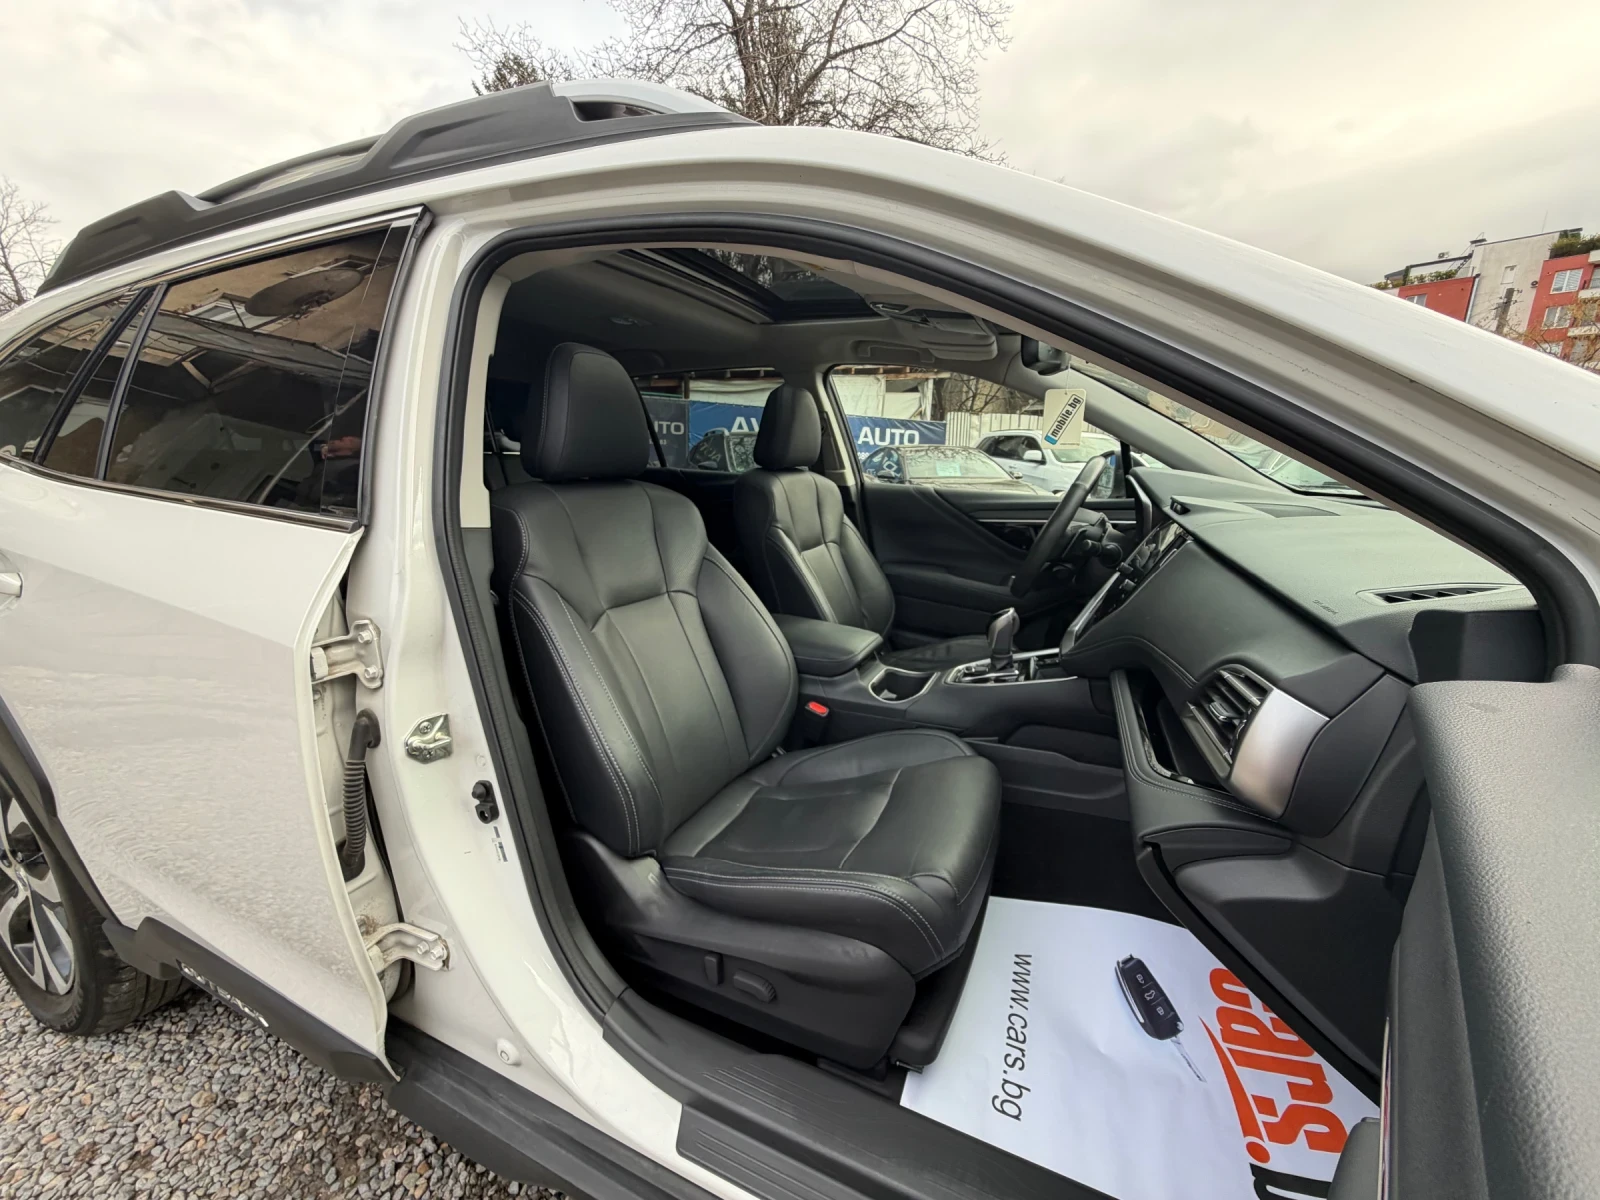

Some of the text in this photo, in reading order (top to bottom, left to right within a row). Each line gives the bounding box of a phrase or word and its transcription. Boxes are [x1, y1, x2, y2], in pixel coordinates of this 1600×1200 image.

[857, 426, 920, 446] AUTO
[1051, 397, 1082, 438] mobile.bg
[992, 953, 1033, 1122] www.cars.bg
